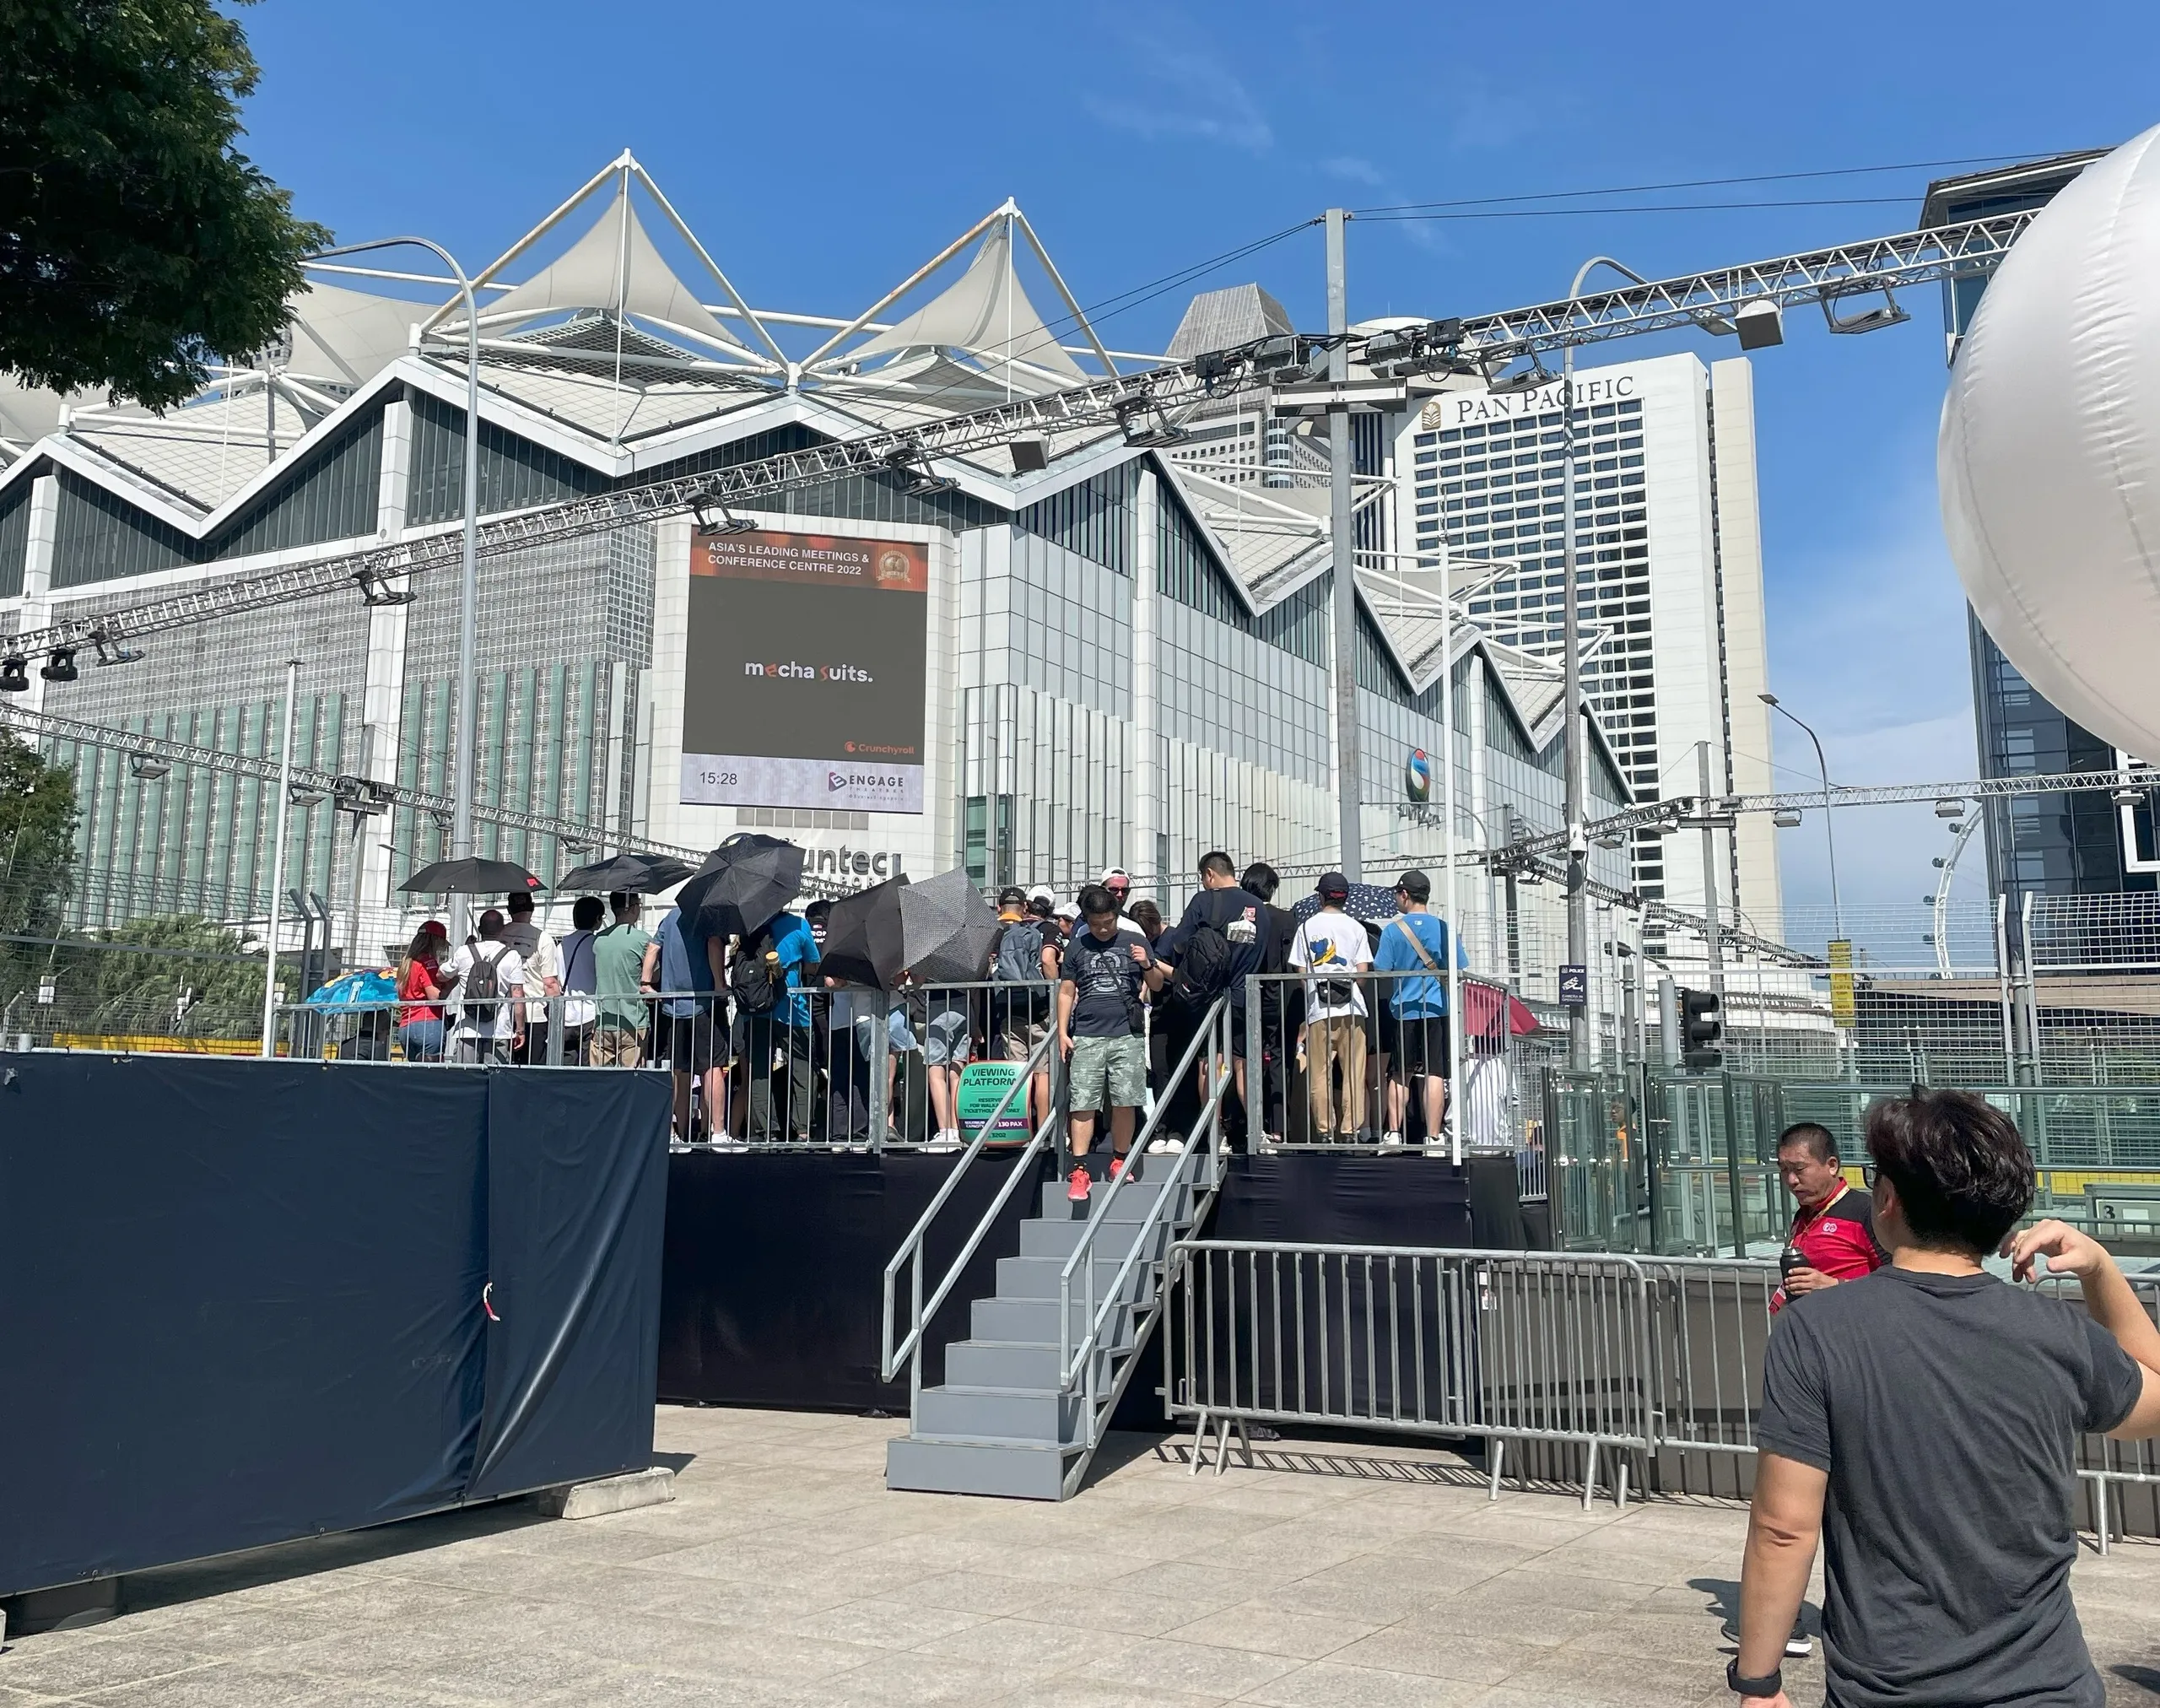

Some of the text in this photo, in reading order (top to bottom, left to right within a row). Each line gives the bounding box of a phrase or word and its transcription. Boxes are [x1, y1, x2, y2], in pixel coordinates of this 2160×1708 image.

[1457, 376, 1634, 423] PAN PACIFIC
[708, 542, 870, 563] ASIA'S LEADING MEETINGS &
[708, 554, 861, 576] CONFERENCE CENTRE 2022
[858, 743, 915, 754] Crunchyroll
[699, 771, 737, 786] 15:28
[849, 775, 904, 787] ENGAGE
[802, 844, 887, 877] untec
[972, 1068, 1015, 1077] VIEWING
[2103, 1205, 2115, 1219] 3
